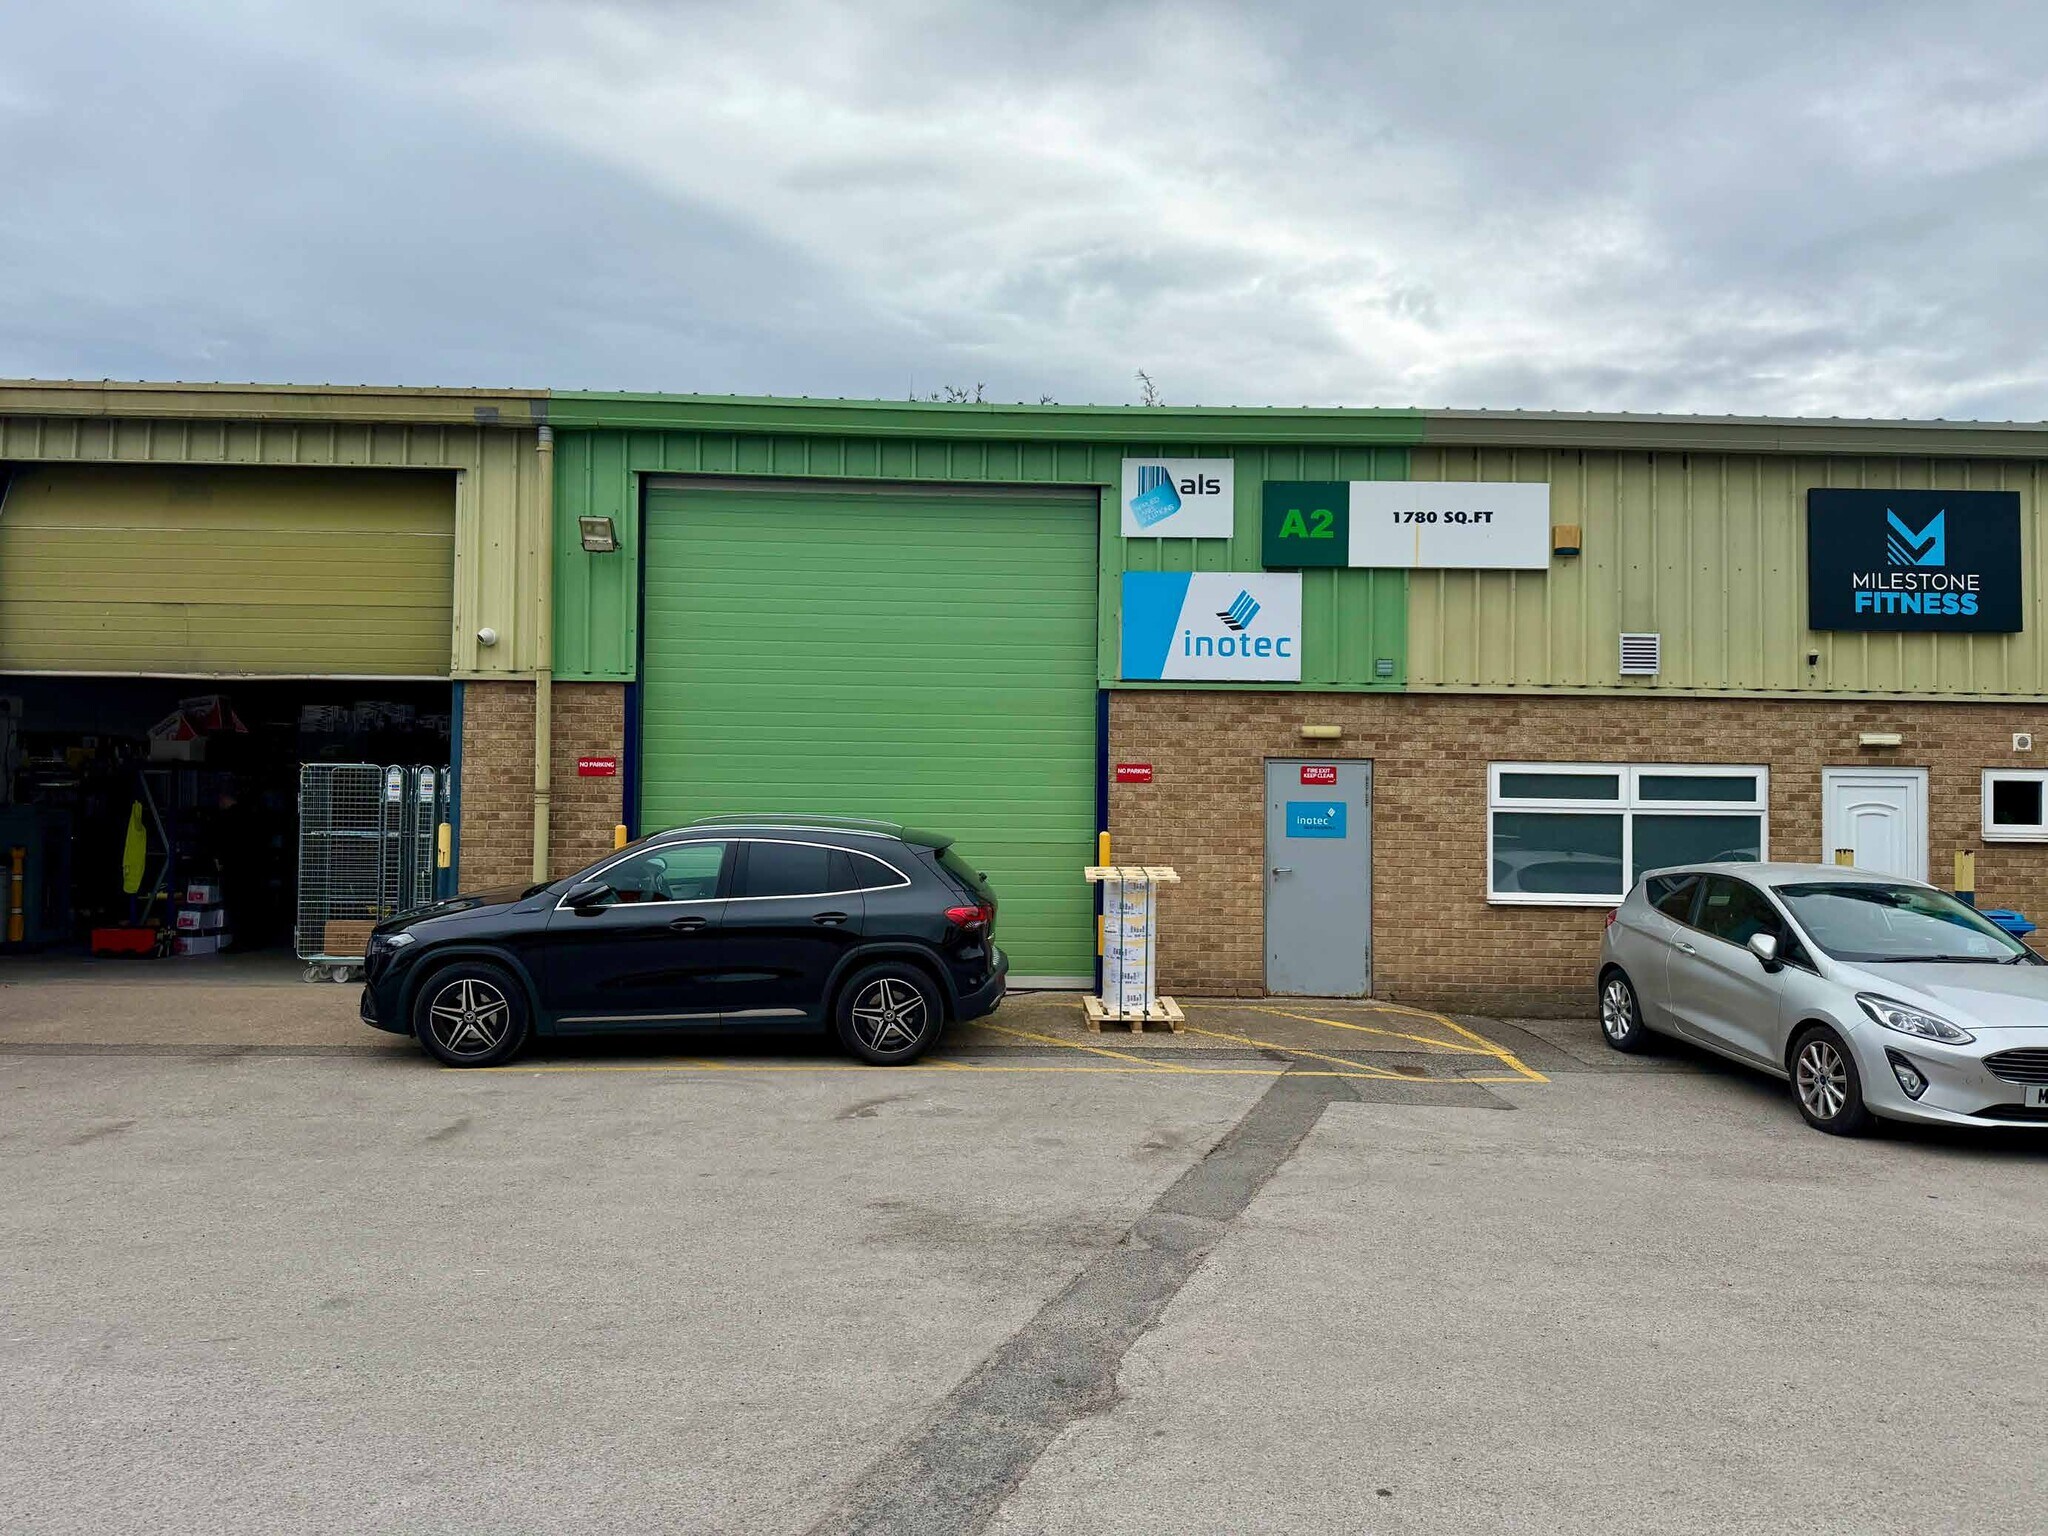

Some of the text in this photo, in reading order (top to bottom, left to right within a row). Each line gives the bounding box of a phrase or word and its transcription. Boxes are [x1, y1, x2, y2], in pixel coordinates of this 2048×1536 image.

[1180, 473, 1221, 495] als
[1278, 509, 1334, 538] A2
[1393, 511, 1494, 525] 1780 SQ.FT
[1853, 572, 1980, 591] MILESTONE
[1855, 591, 1979, 616] FITNESS
[1184, 629, 1291, 658] inotec
[1297, 816, 1328, 825] inotec
